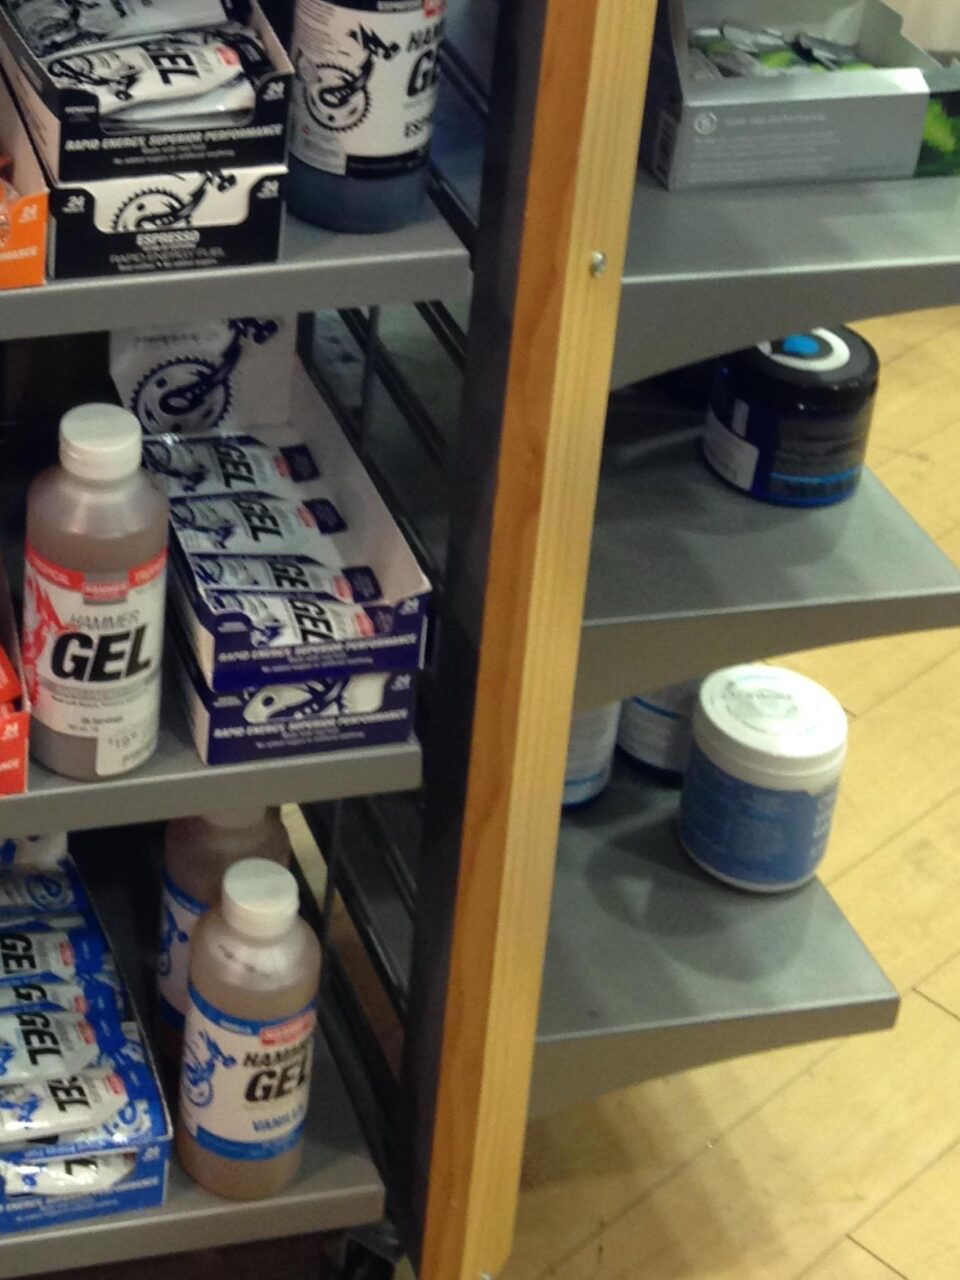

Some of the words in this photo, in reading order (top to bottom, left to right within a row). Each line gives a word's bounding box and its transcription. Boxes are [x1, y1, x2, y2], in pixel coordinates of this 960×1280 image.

[65, 138, 100, 152] RAPID
[204, 123, 284, 141] PERFORMANCE
[213, 444, 256, 489] GEL
[232, 498, 285, 542] GEL
[267, 561, 310, 589] GE
[70, 609, 140, 630] HAMMER
[289, 598, 338, 643] GEL
[51, 623, 152, 683] GEL
[0, 933, 38, 975] GE
[17, 1012, 63, 1066] GEL
